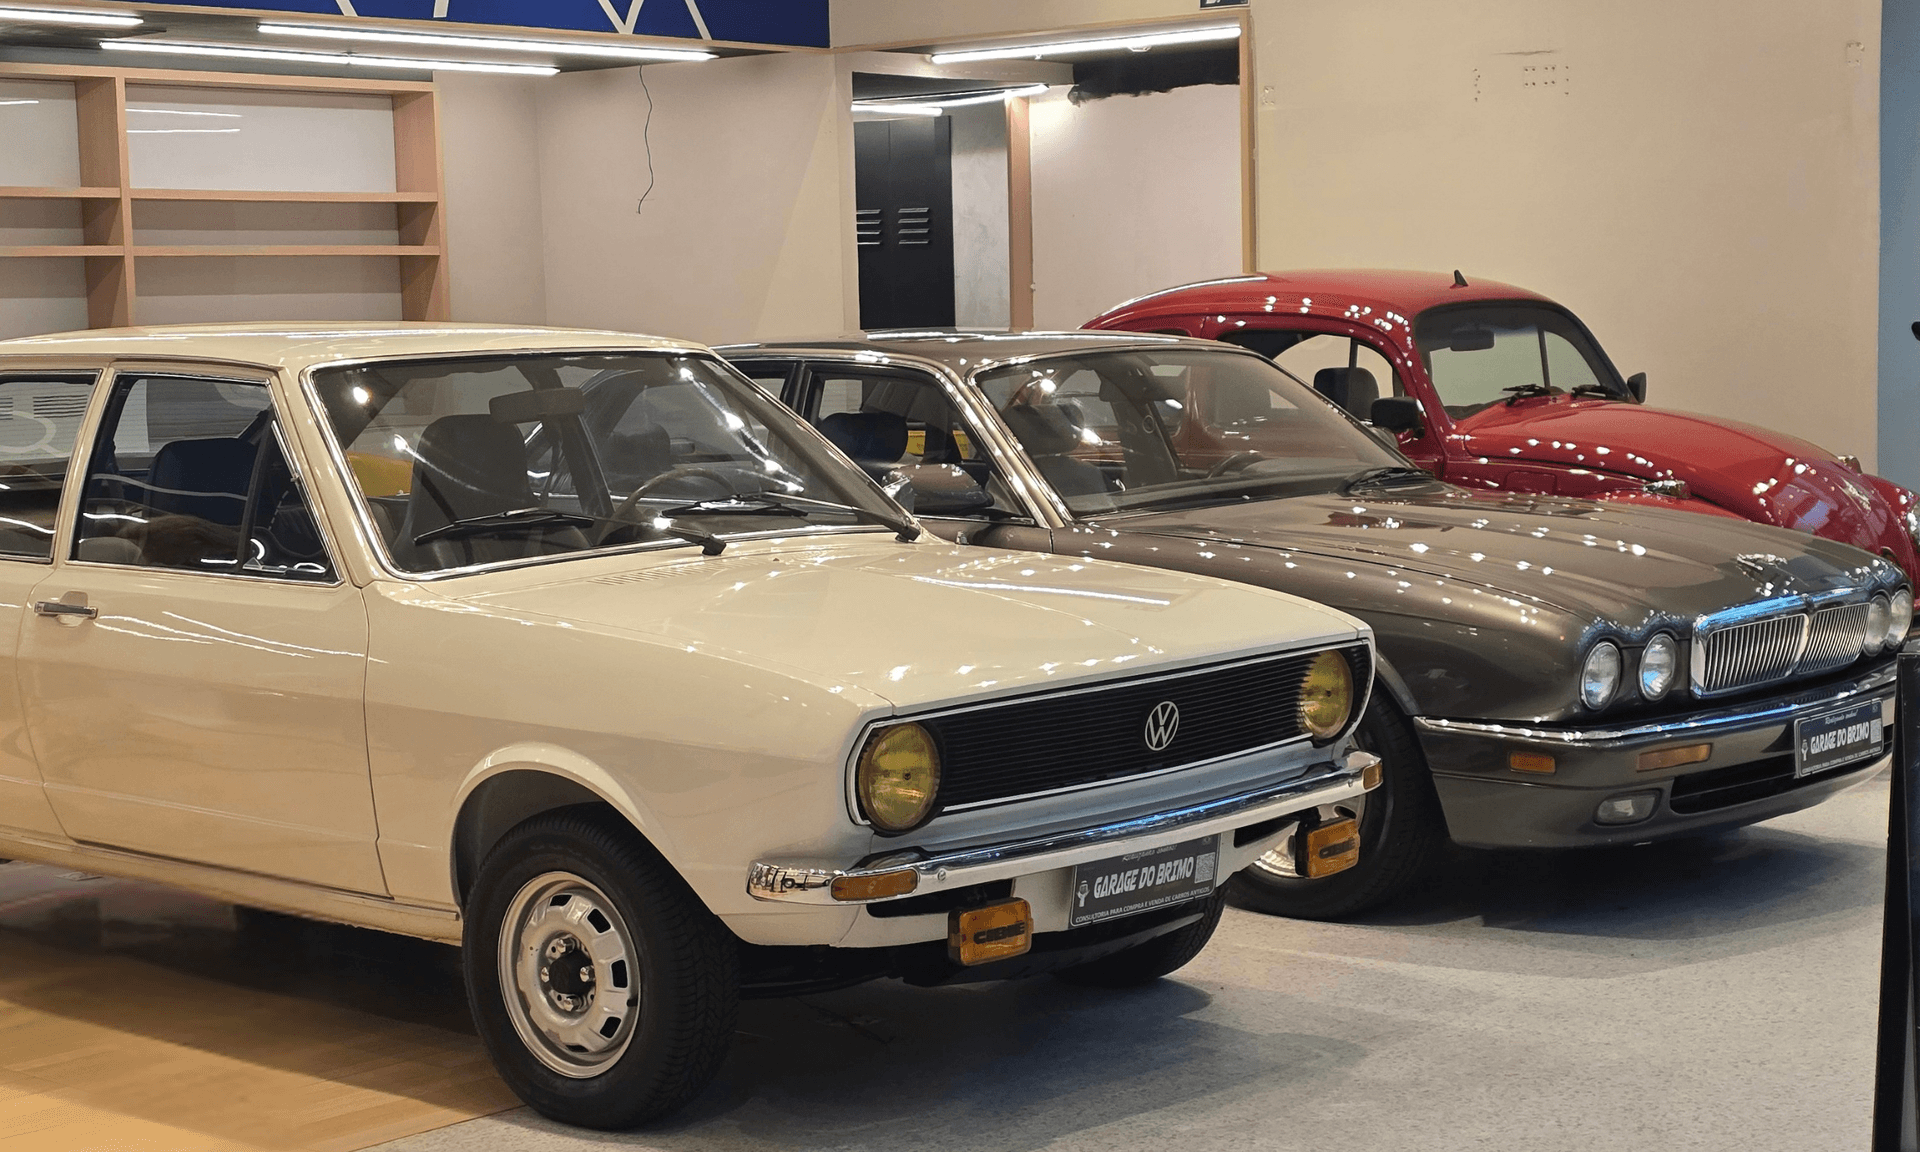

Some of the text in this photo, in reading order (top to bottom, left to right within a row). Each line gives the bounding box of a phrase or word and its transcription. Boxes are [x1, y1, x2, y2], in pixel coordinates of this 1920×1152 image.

[1811, 721, 1870, 755] GARAGE DO BRIMO
[1094, 856, 1194, 899] GARAGE DO BRIMO
[1075, 909, 1110, 923] CONSULTORIA
[1109, 905, 1123, 916] PARA
[1123, 901, 1145, 912] COMPRA
[1148, 897, 1165, 907] VENDA
[1164, 895, 1172, 903] DE
[1171, 892, 1190, 901] CARROS
[1190, 886, 1210, 896] ANTIGOS
